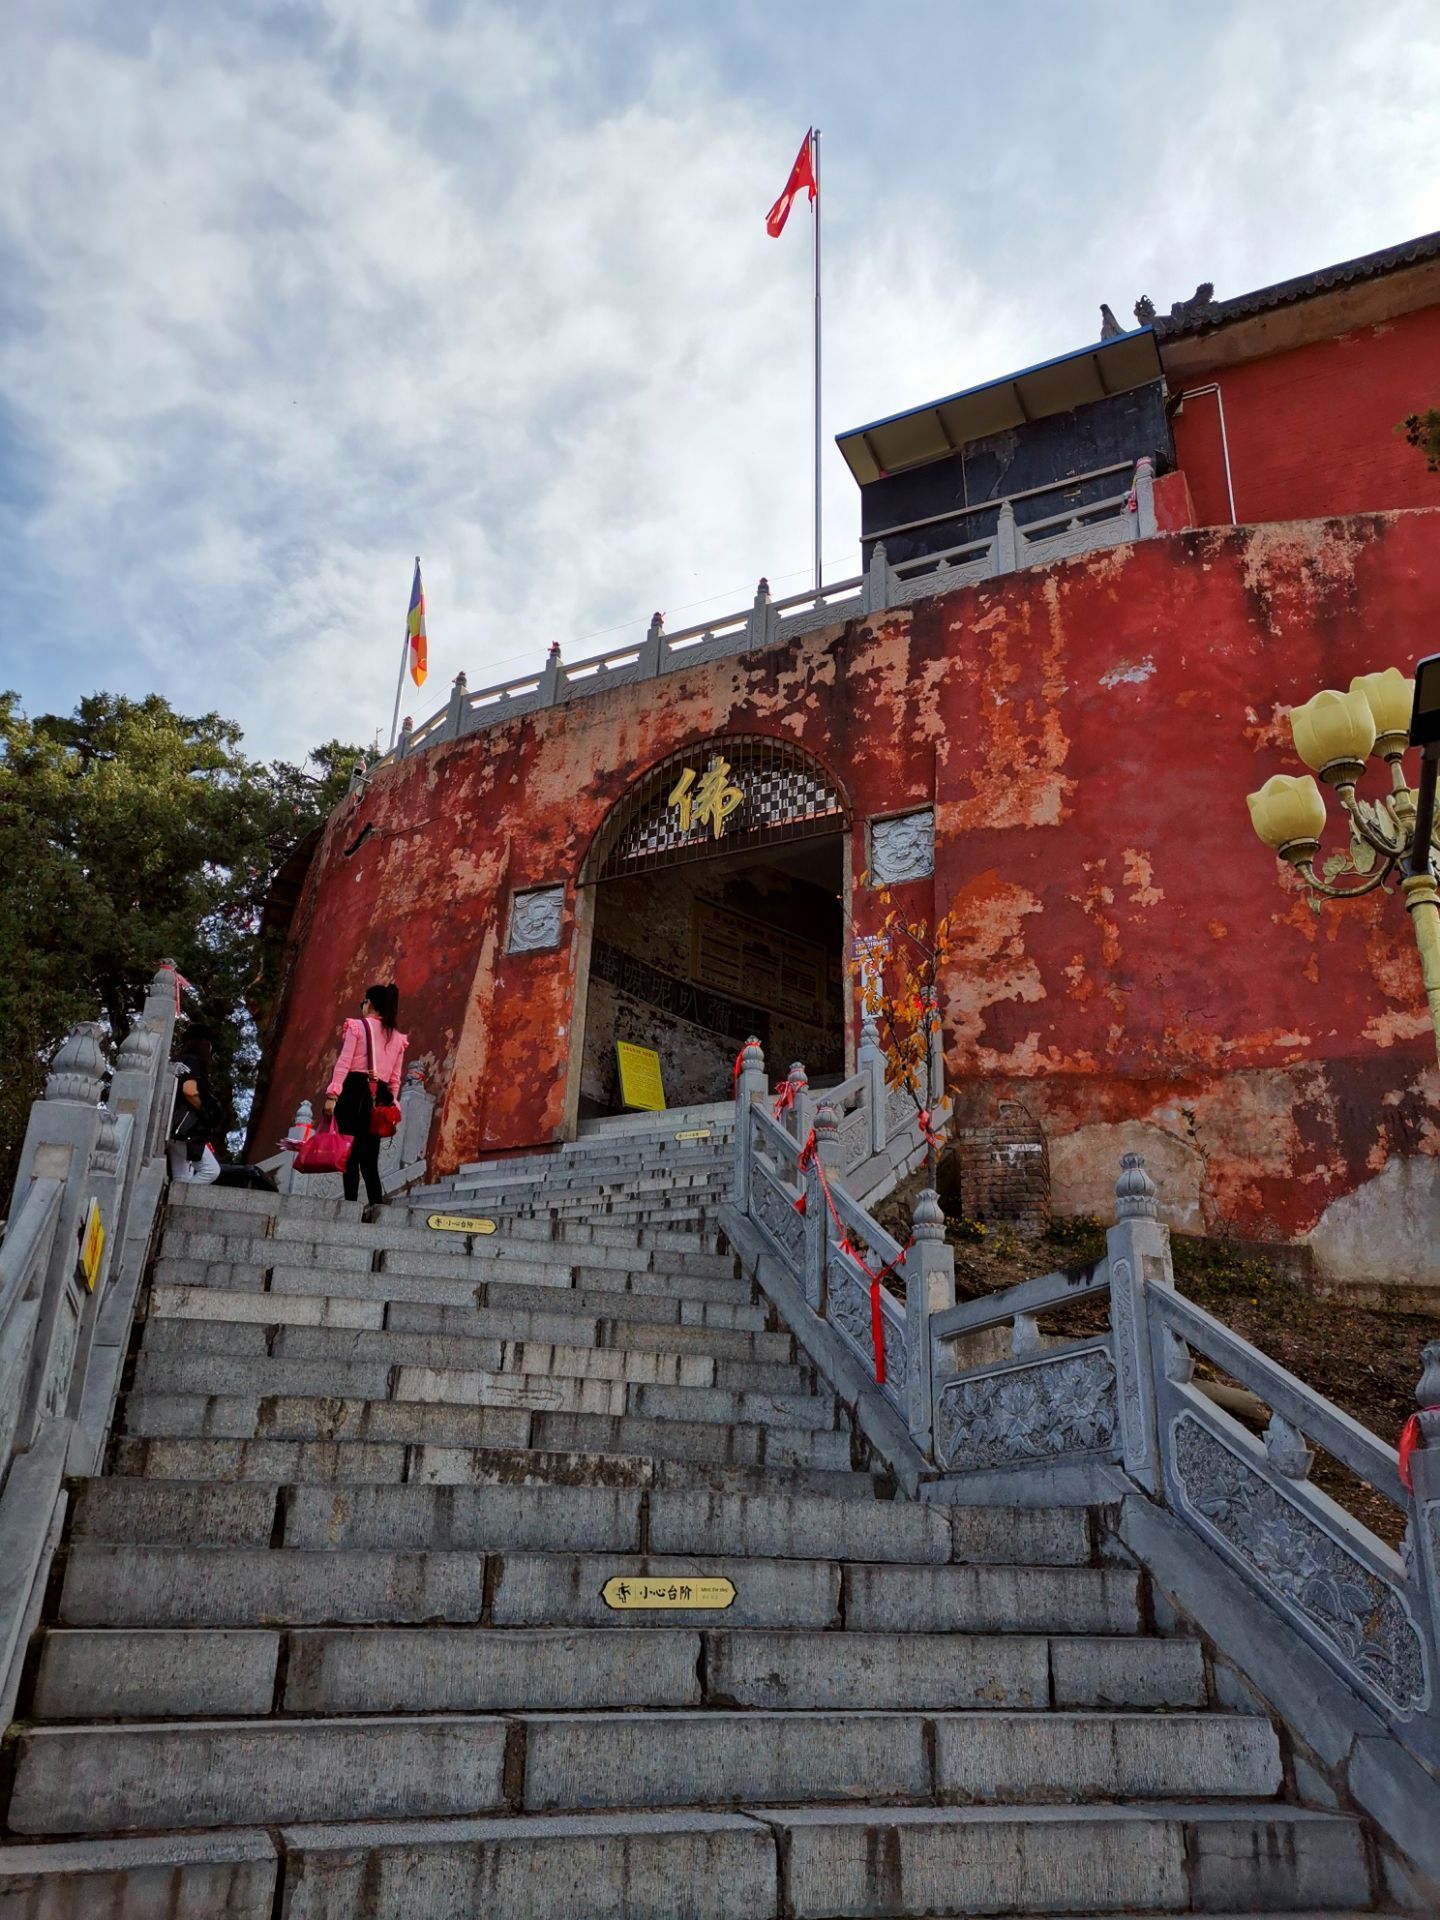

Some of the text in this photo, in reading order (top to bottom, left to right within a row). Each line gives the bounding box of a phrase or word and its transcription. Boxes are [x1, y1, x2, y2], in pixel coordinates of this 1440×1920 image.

[668, 756, 743, 839] 佛
[639, 1585, 693, 1601] 小心台阶
